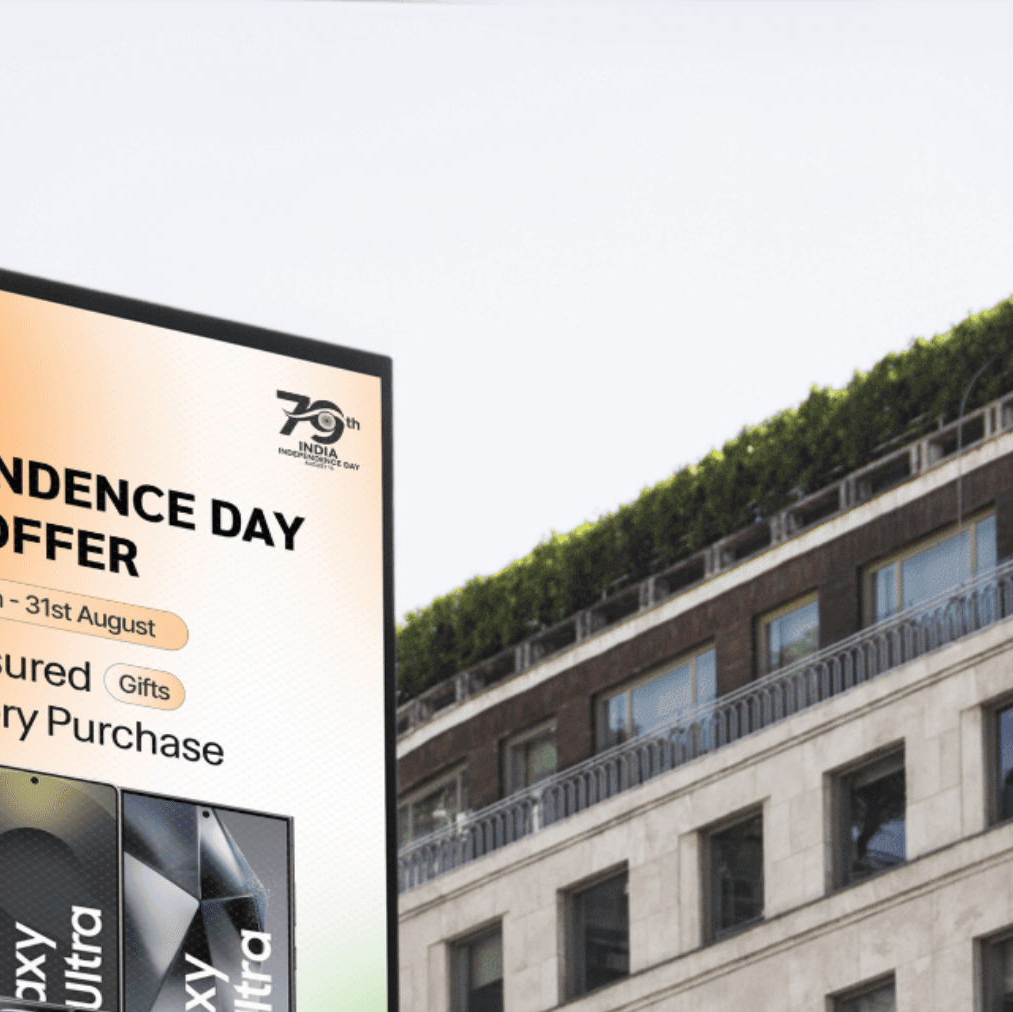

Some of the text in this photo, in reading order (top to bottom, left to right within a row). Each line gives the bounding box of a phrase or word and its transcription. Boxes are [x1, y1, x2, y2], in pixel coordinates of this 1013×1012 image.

[278, 447, 361, 471] INDEPENDENCE DAY
[298, 441, 339, 459] INDIA
[211, 498, 306, 552] DAY
[25, 595, 72, 622] 31st
[77, 605, 157, 638] August
[118, 674, 171, 702] Gifts
[48, 705, 225, 767] Purchase
[64, 905, 103, 1010] Ultra
